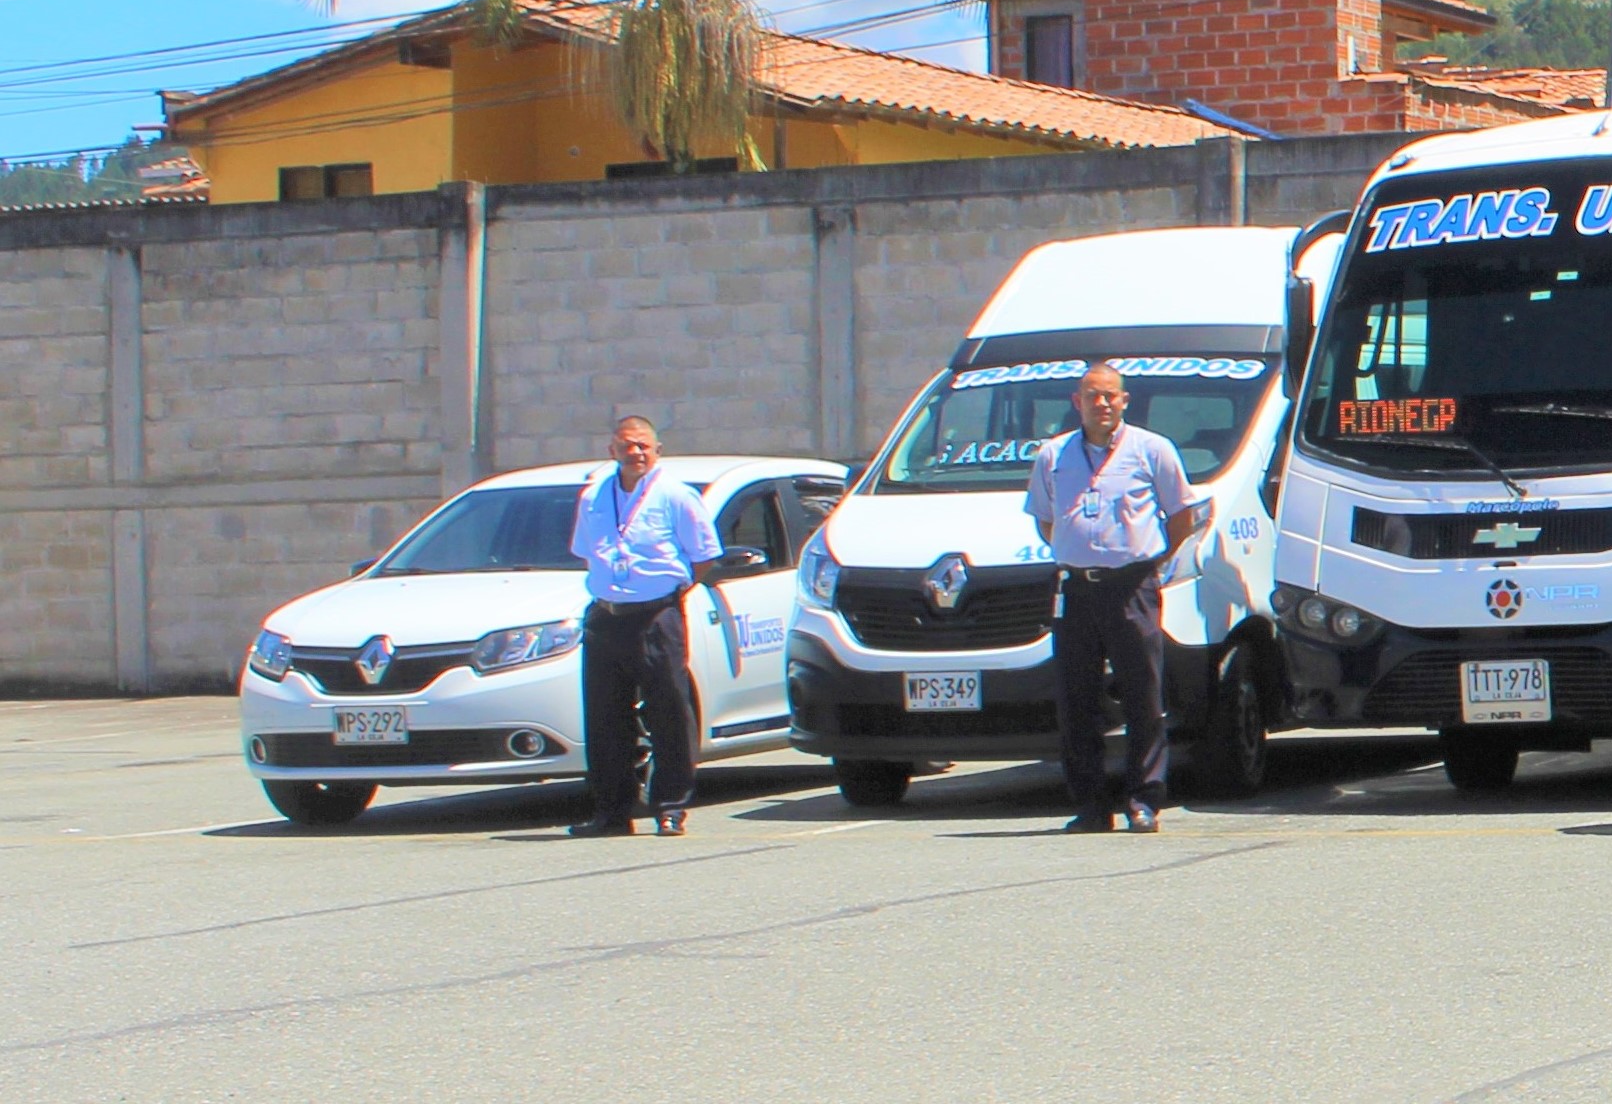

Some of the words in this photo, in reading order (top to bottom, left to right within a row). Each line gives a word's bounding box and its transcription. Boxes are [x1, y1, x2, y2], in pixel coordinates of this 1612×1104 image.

[1365, 187, 1559, 253] TRANS.
[1229, 517, 1259, 540] 403
[1525, 584, 1600, 601] NPR
[751, 628, 784, 646] UNIDOS
[1490, 711, 1522, 720] NPR
